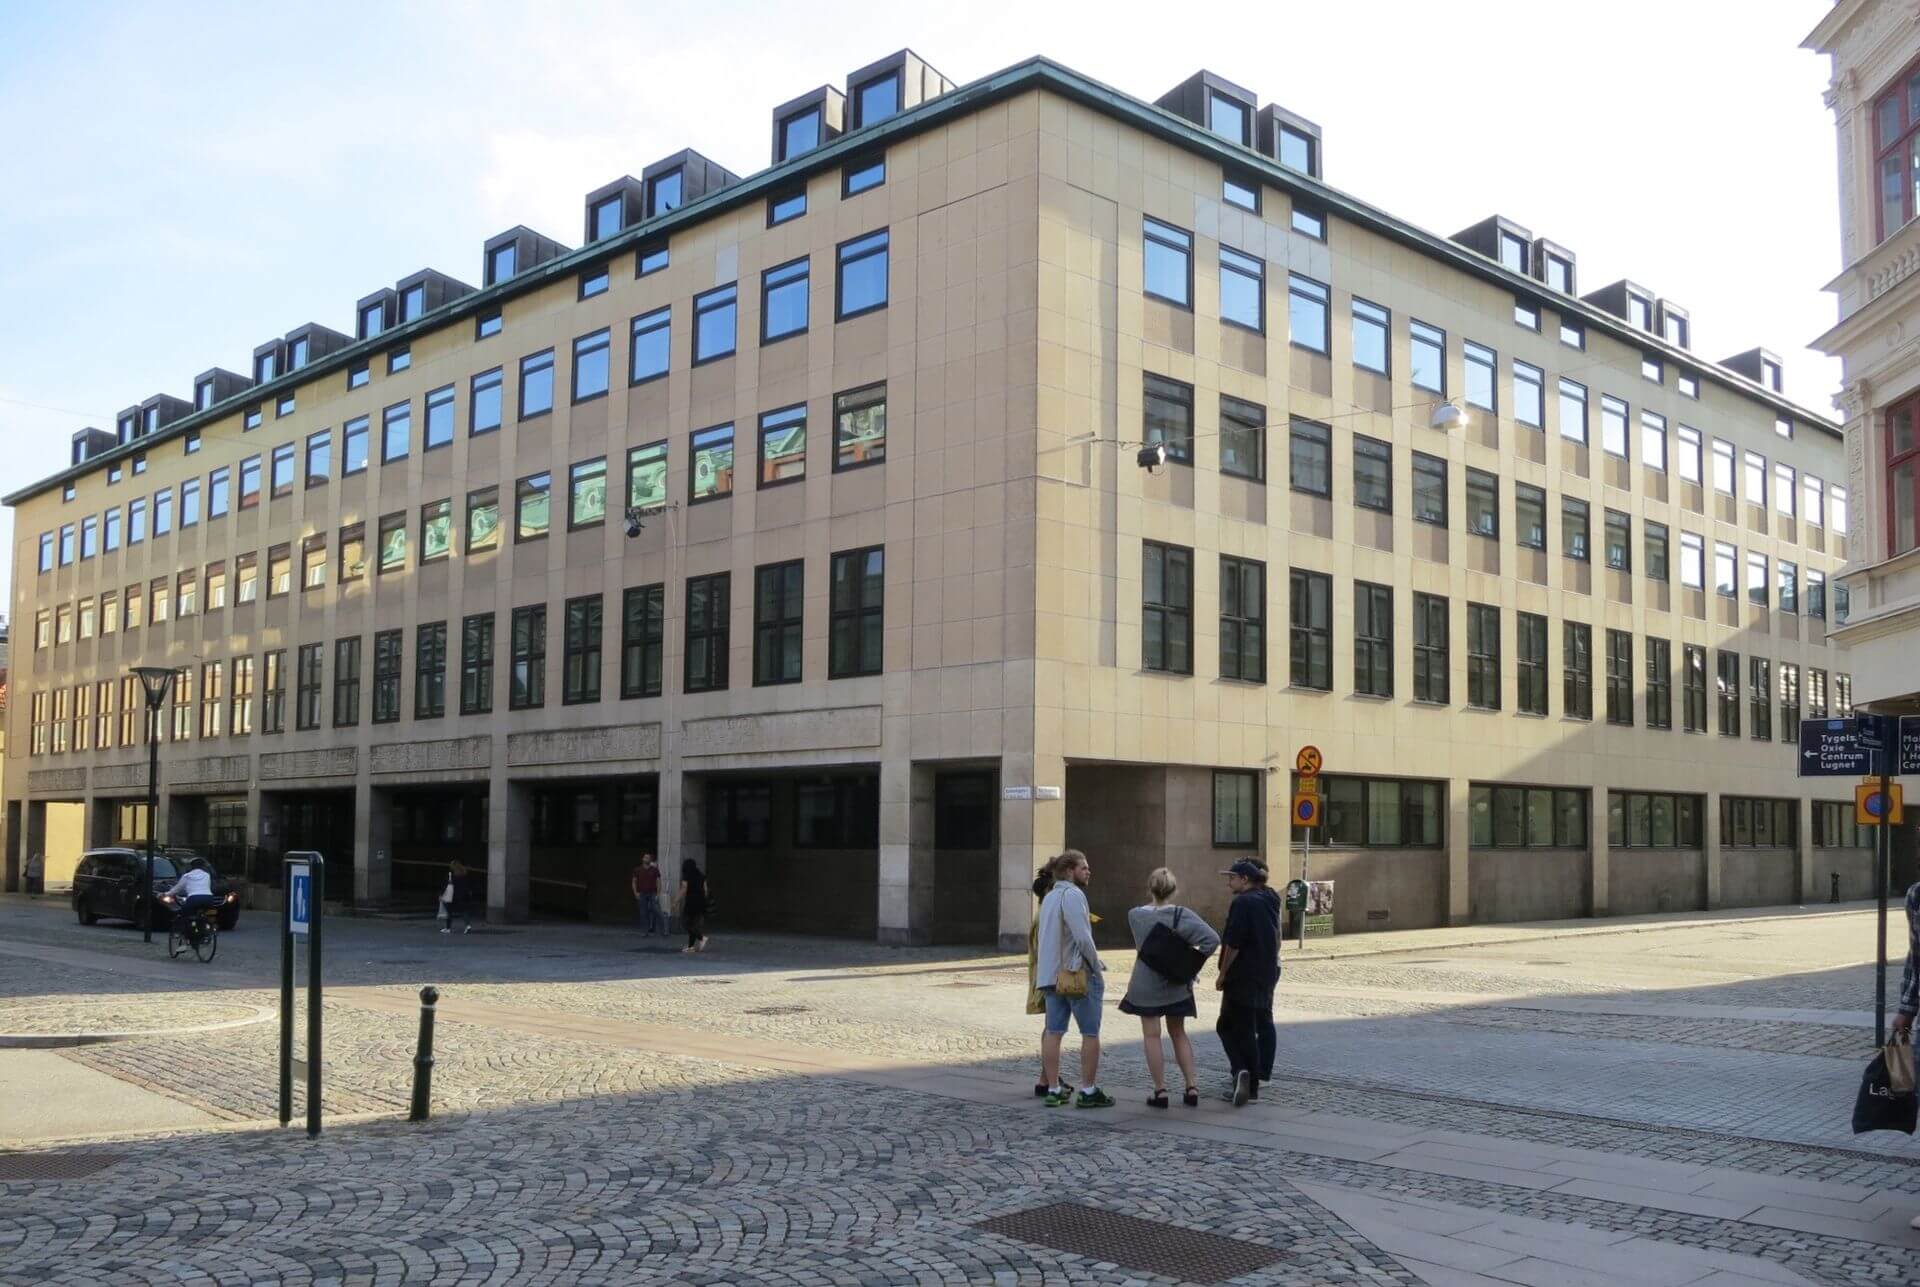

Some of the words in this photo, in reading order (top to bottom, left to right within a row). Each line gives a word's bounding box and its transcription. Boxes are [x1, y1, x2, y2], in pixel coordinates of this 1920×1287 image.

[1820, 734, 1858, 743] Tygels
[1820, 752, 1864, 760] Centrum
[1820, 760, 1855, 770] Lugnet
